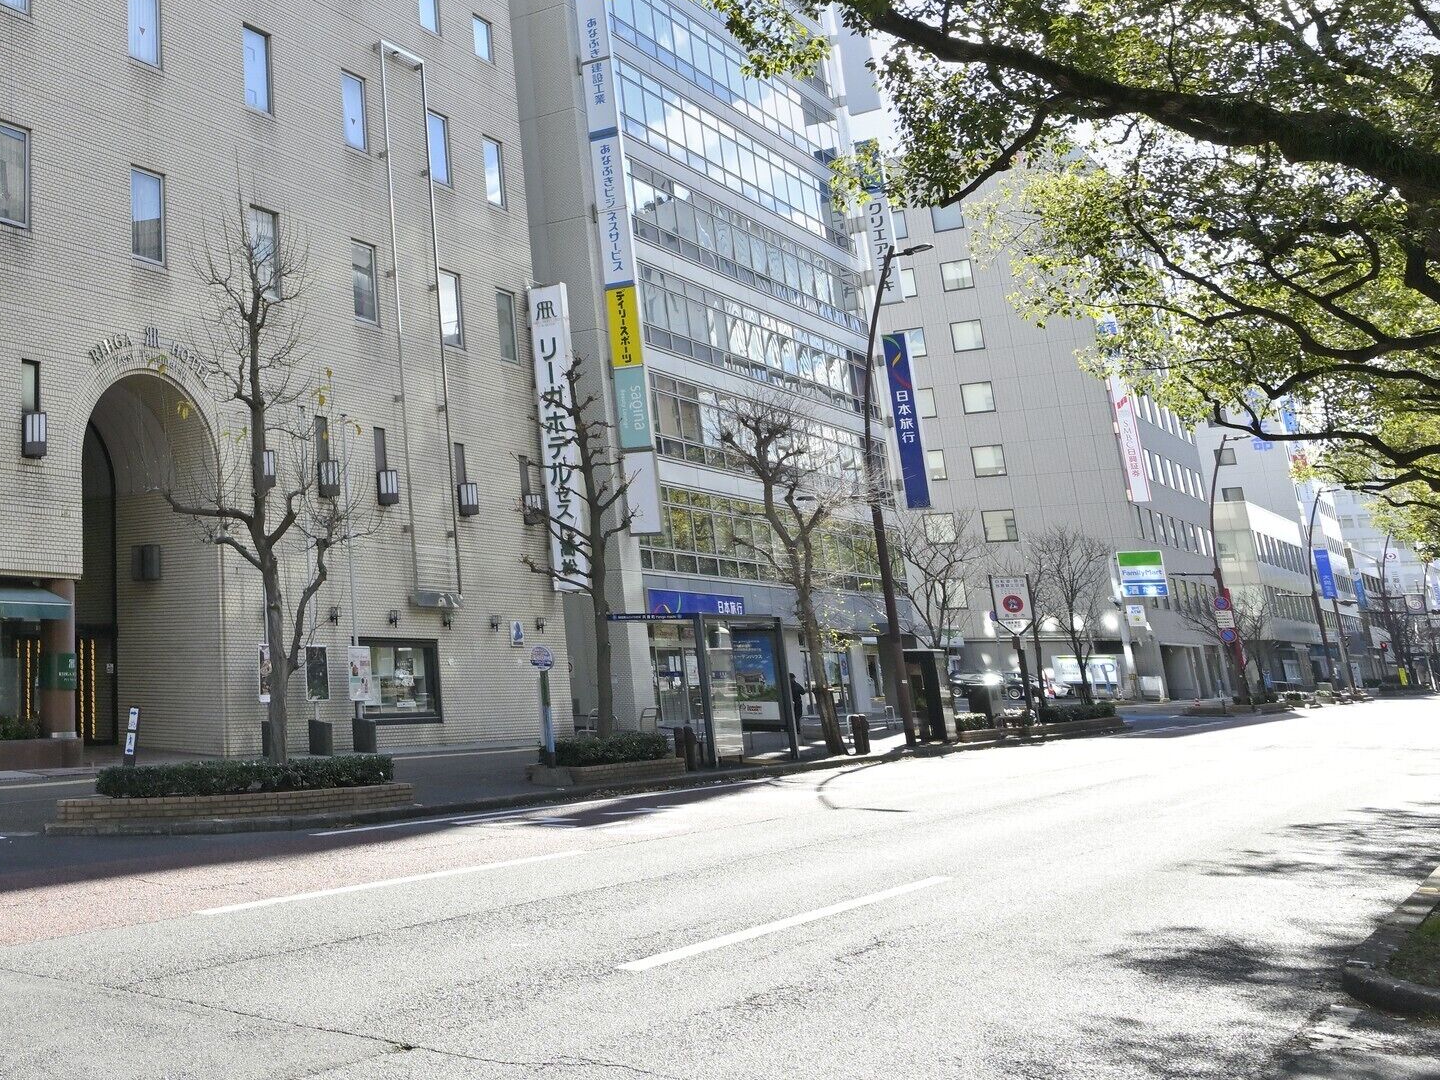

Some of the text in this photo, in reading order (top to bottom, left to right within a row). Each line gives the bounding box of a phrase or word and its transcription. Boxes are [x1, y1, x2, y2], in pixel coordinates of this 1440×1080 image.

[587, 18, 606, 105] あなぶき建設工業
[600, 144, 623, 272] あなぶきビジネスサービス
[89, 332, 133, 365] RIHGA
[616, 289, 632, 363] デイリースポーツ
[896, 390, 915, 443] 日本旅行
[717, 600, 743, 615] 日本旅行
